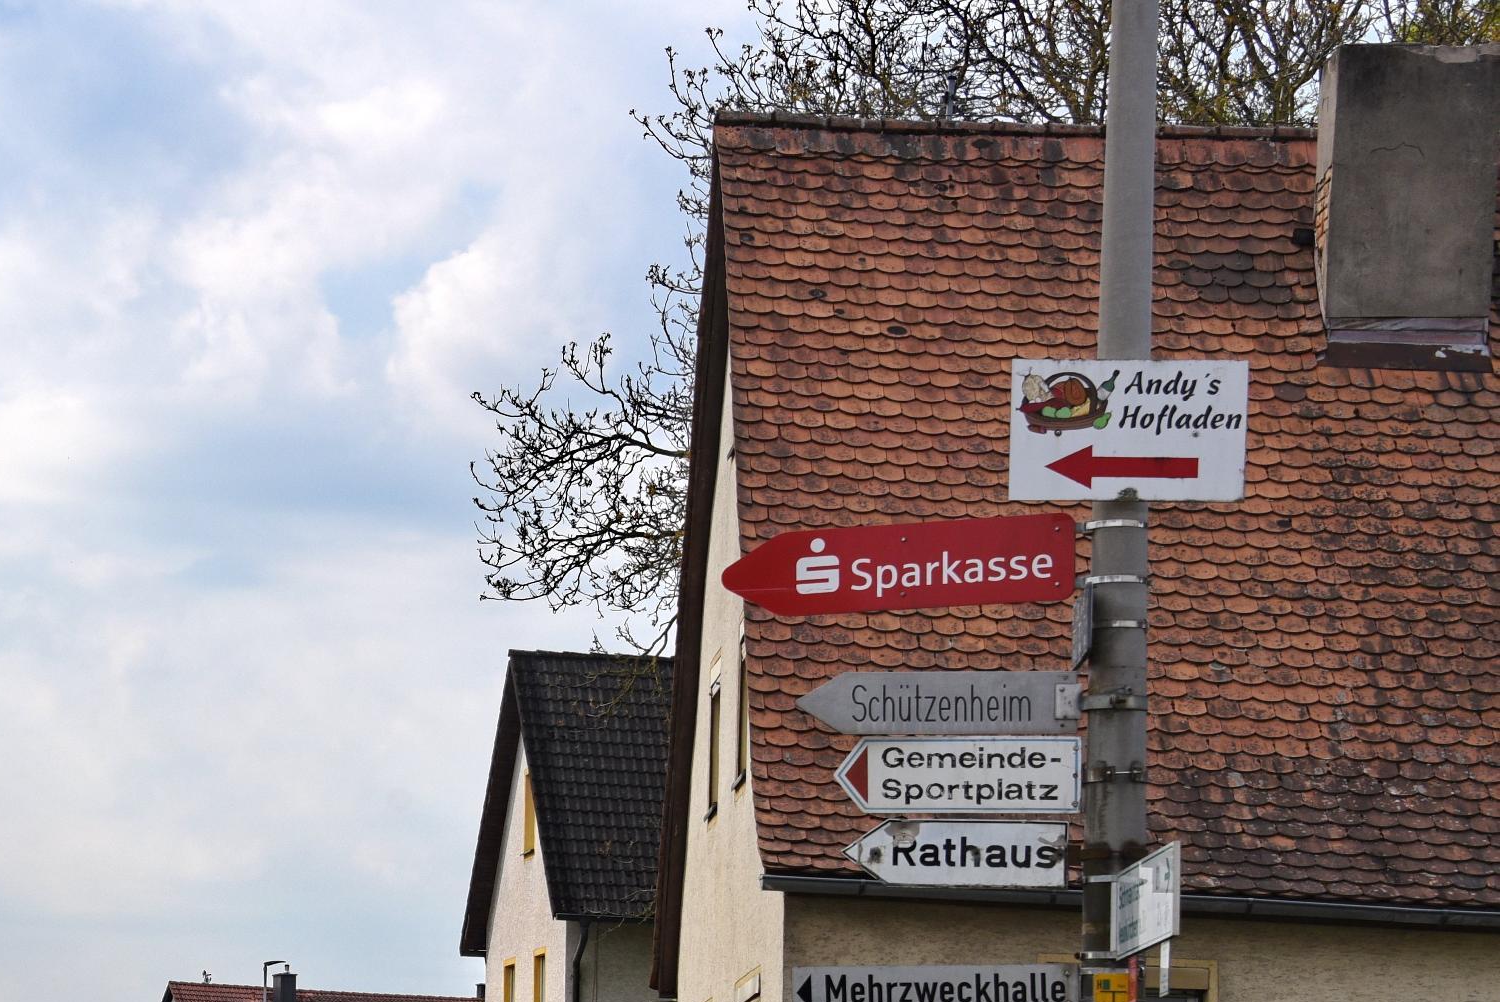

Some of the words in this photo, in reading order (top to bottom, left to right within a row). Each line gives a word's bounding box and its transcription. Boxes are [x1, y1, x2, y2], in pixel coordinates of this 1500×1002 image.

[1118, 404, 1243, 436] Hofladen
[851, 551, 1054, 598] Sparkasse
[851, 683, 1032, 723] Schützenheim
[881, 746, 1062, 769] Gemeinde-
[881, 778, 1060, 805] Sportplatz
[891, 835, 1059, 869] Rathaus
